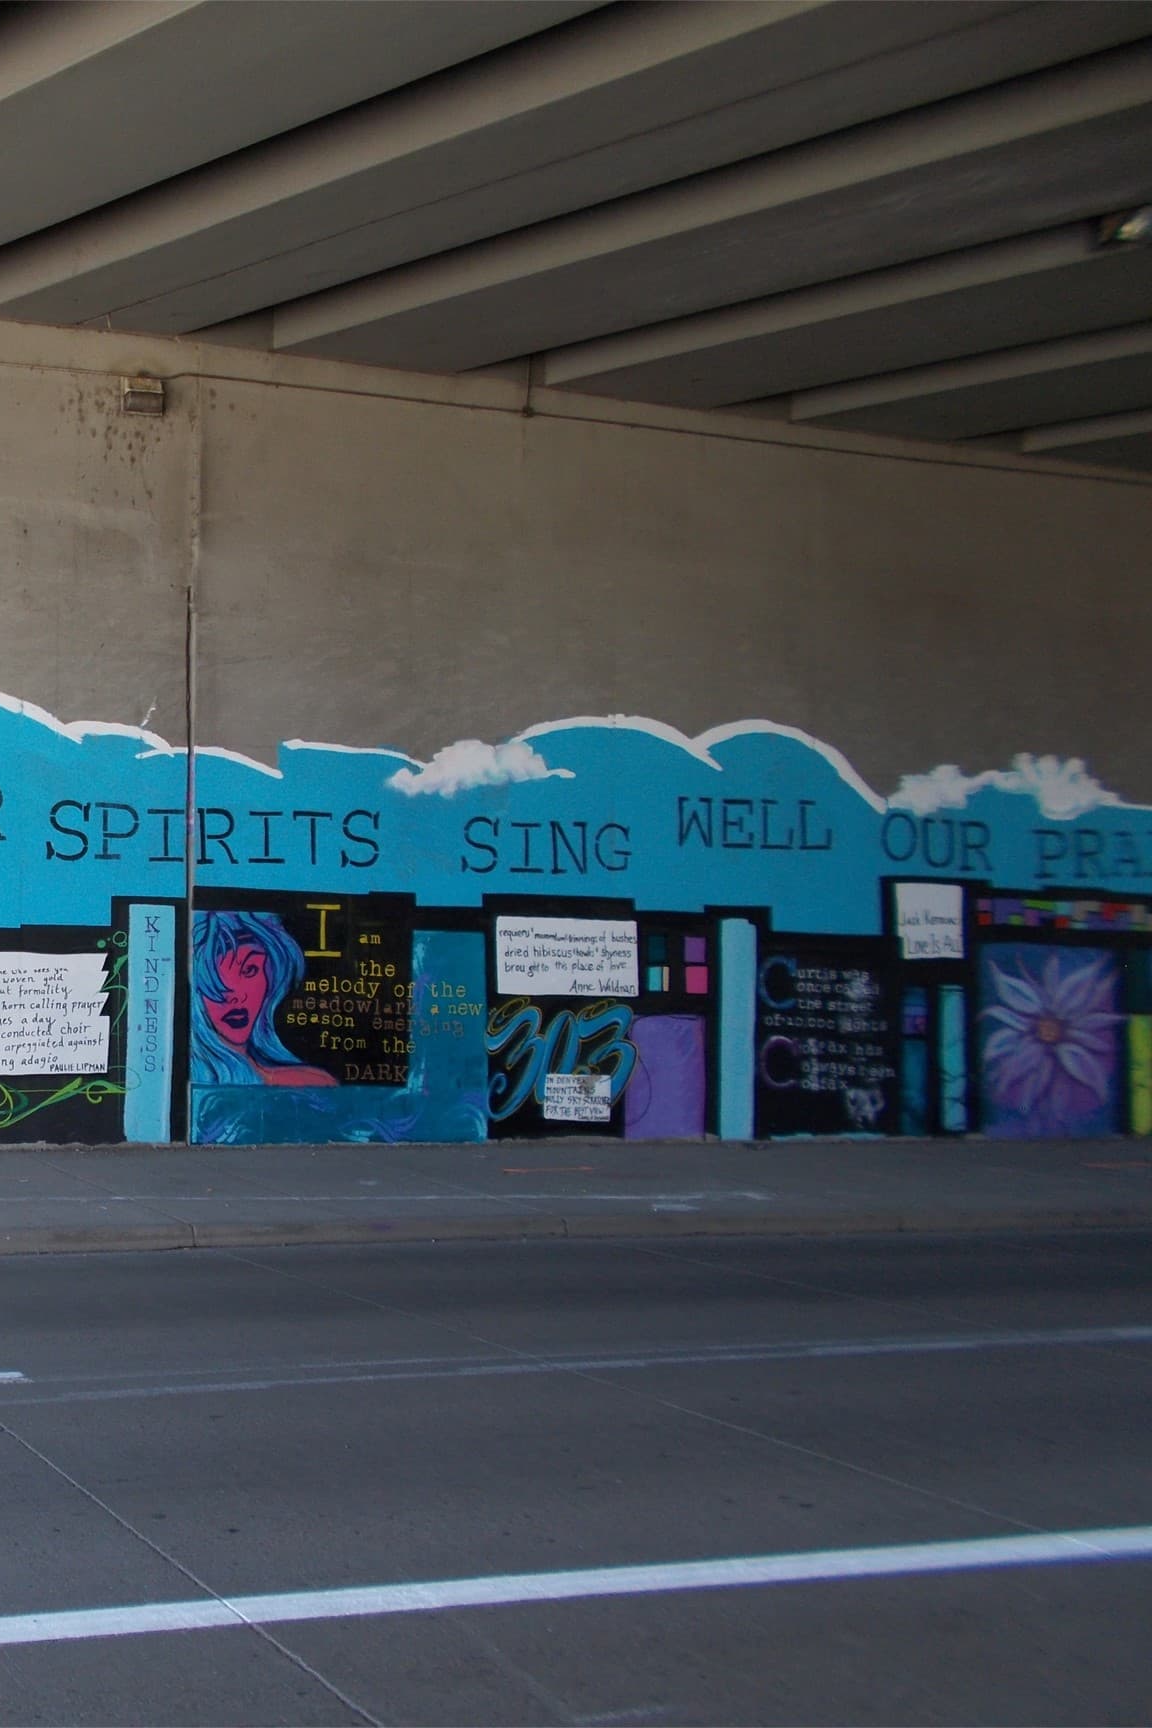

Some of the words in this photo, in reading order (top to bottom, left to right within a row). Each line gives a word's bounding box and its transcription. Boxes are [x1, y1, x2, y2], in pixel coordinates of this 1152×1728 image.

[46, 800, 380, 867] SPIRITS
[461, 816, 632, 875] SING
[677, 797, 832, 850] WELL
[881, 812, 993, 871] OUR
[1032, 828, 1152, 879] PRA
[304, 904, 342, 957] I
[359, 933, 381, 945] am
[504, 945, 529, 958] dried
[533, 944, 572, 958] hibiscus
[360, 960, 396, 977] the
[571, 961, 593, 975] place
[3, 976, 35, 984] woven
[43, 974, 64, 987] gold
[305, 976, 381, 999] melody
[394, 982, 416, 998] of
[430, 981, 466, 998] the
[569, 979, 595, 995] Anne
[796, 981, 832, 993] once
[144, 915, 161, 1073] KINDNESS
[3, 1001, 26, 1010] horn
[30, 998, 67, 1015] calling
[72, 1001, 104, 1015] prayer
[430, 1003, 440, 1016] a
[448, 1002, 483, 1016] new
[287, 1012, 355, 1027] season
[1, 1026, 53, 1039] conducted
[60, 1022, 91, 1035] choir
[68, 1032, 104, 1052] against
[319, 1031, 367, 1051] from
[383, 1037, 416, 1053] the
[21, 1053, 58, 1068] adagio
[49, 1063, 74, 1073] PAULIE
[76, 1063, 105, 1072] LIPMAN
[344, 1063, 409, 1082] DARK
